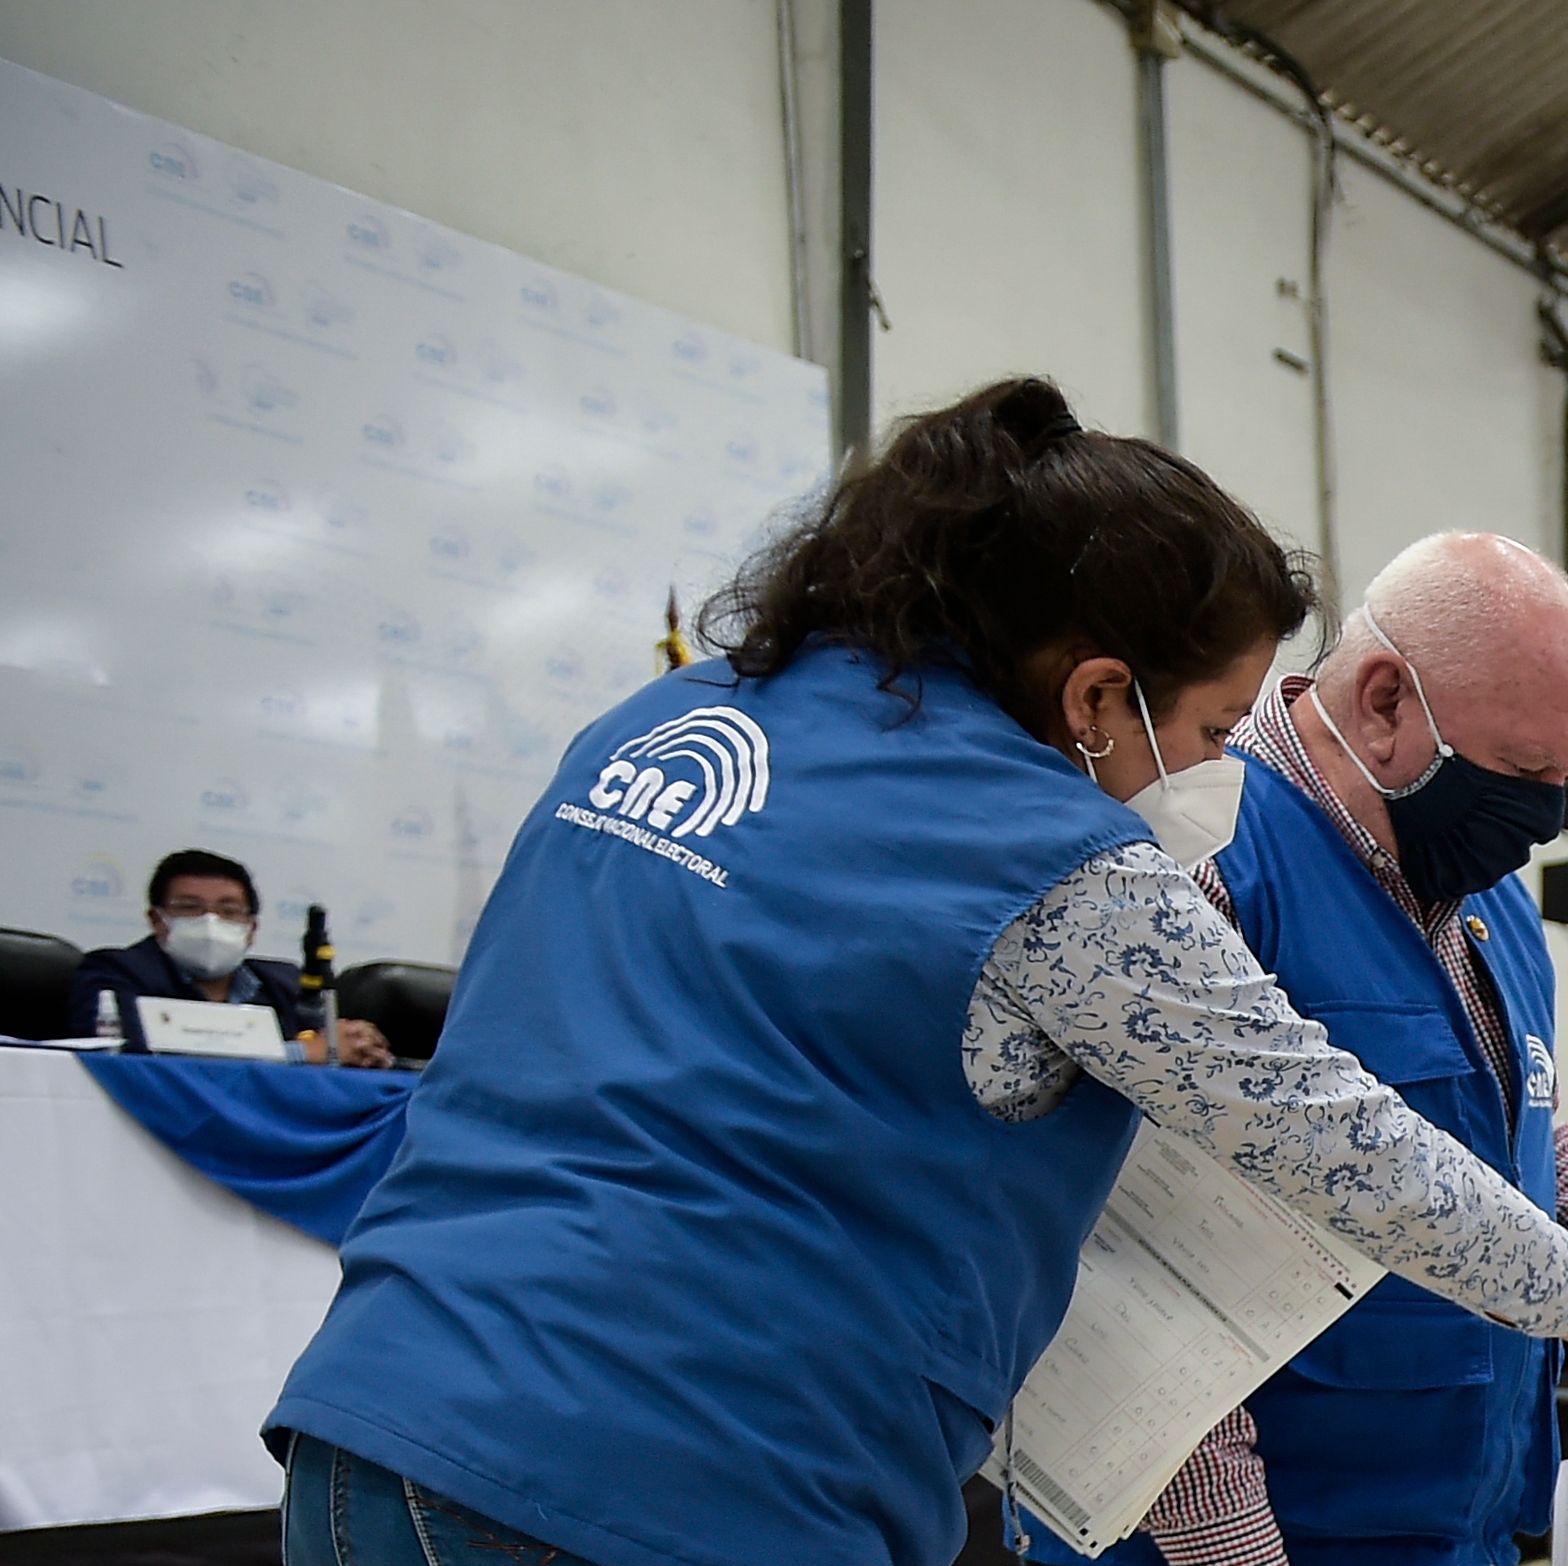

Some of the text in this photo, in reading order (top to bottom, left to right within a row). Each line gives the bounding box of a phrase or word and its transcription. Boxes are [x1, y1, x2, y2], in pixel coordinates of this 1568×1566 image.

[0, 183, 123, 269] NCIAL
[589, 760, 697, 831] CNE
[650, 833, 730, 878] ELECTORAL
